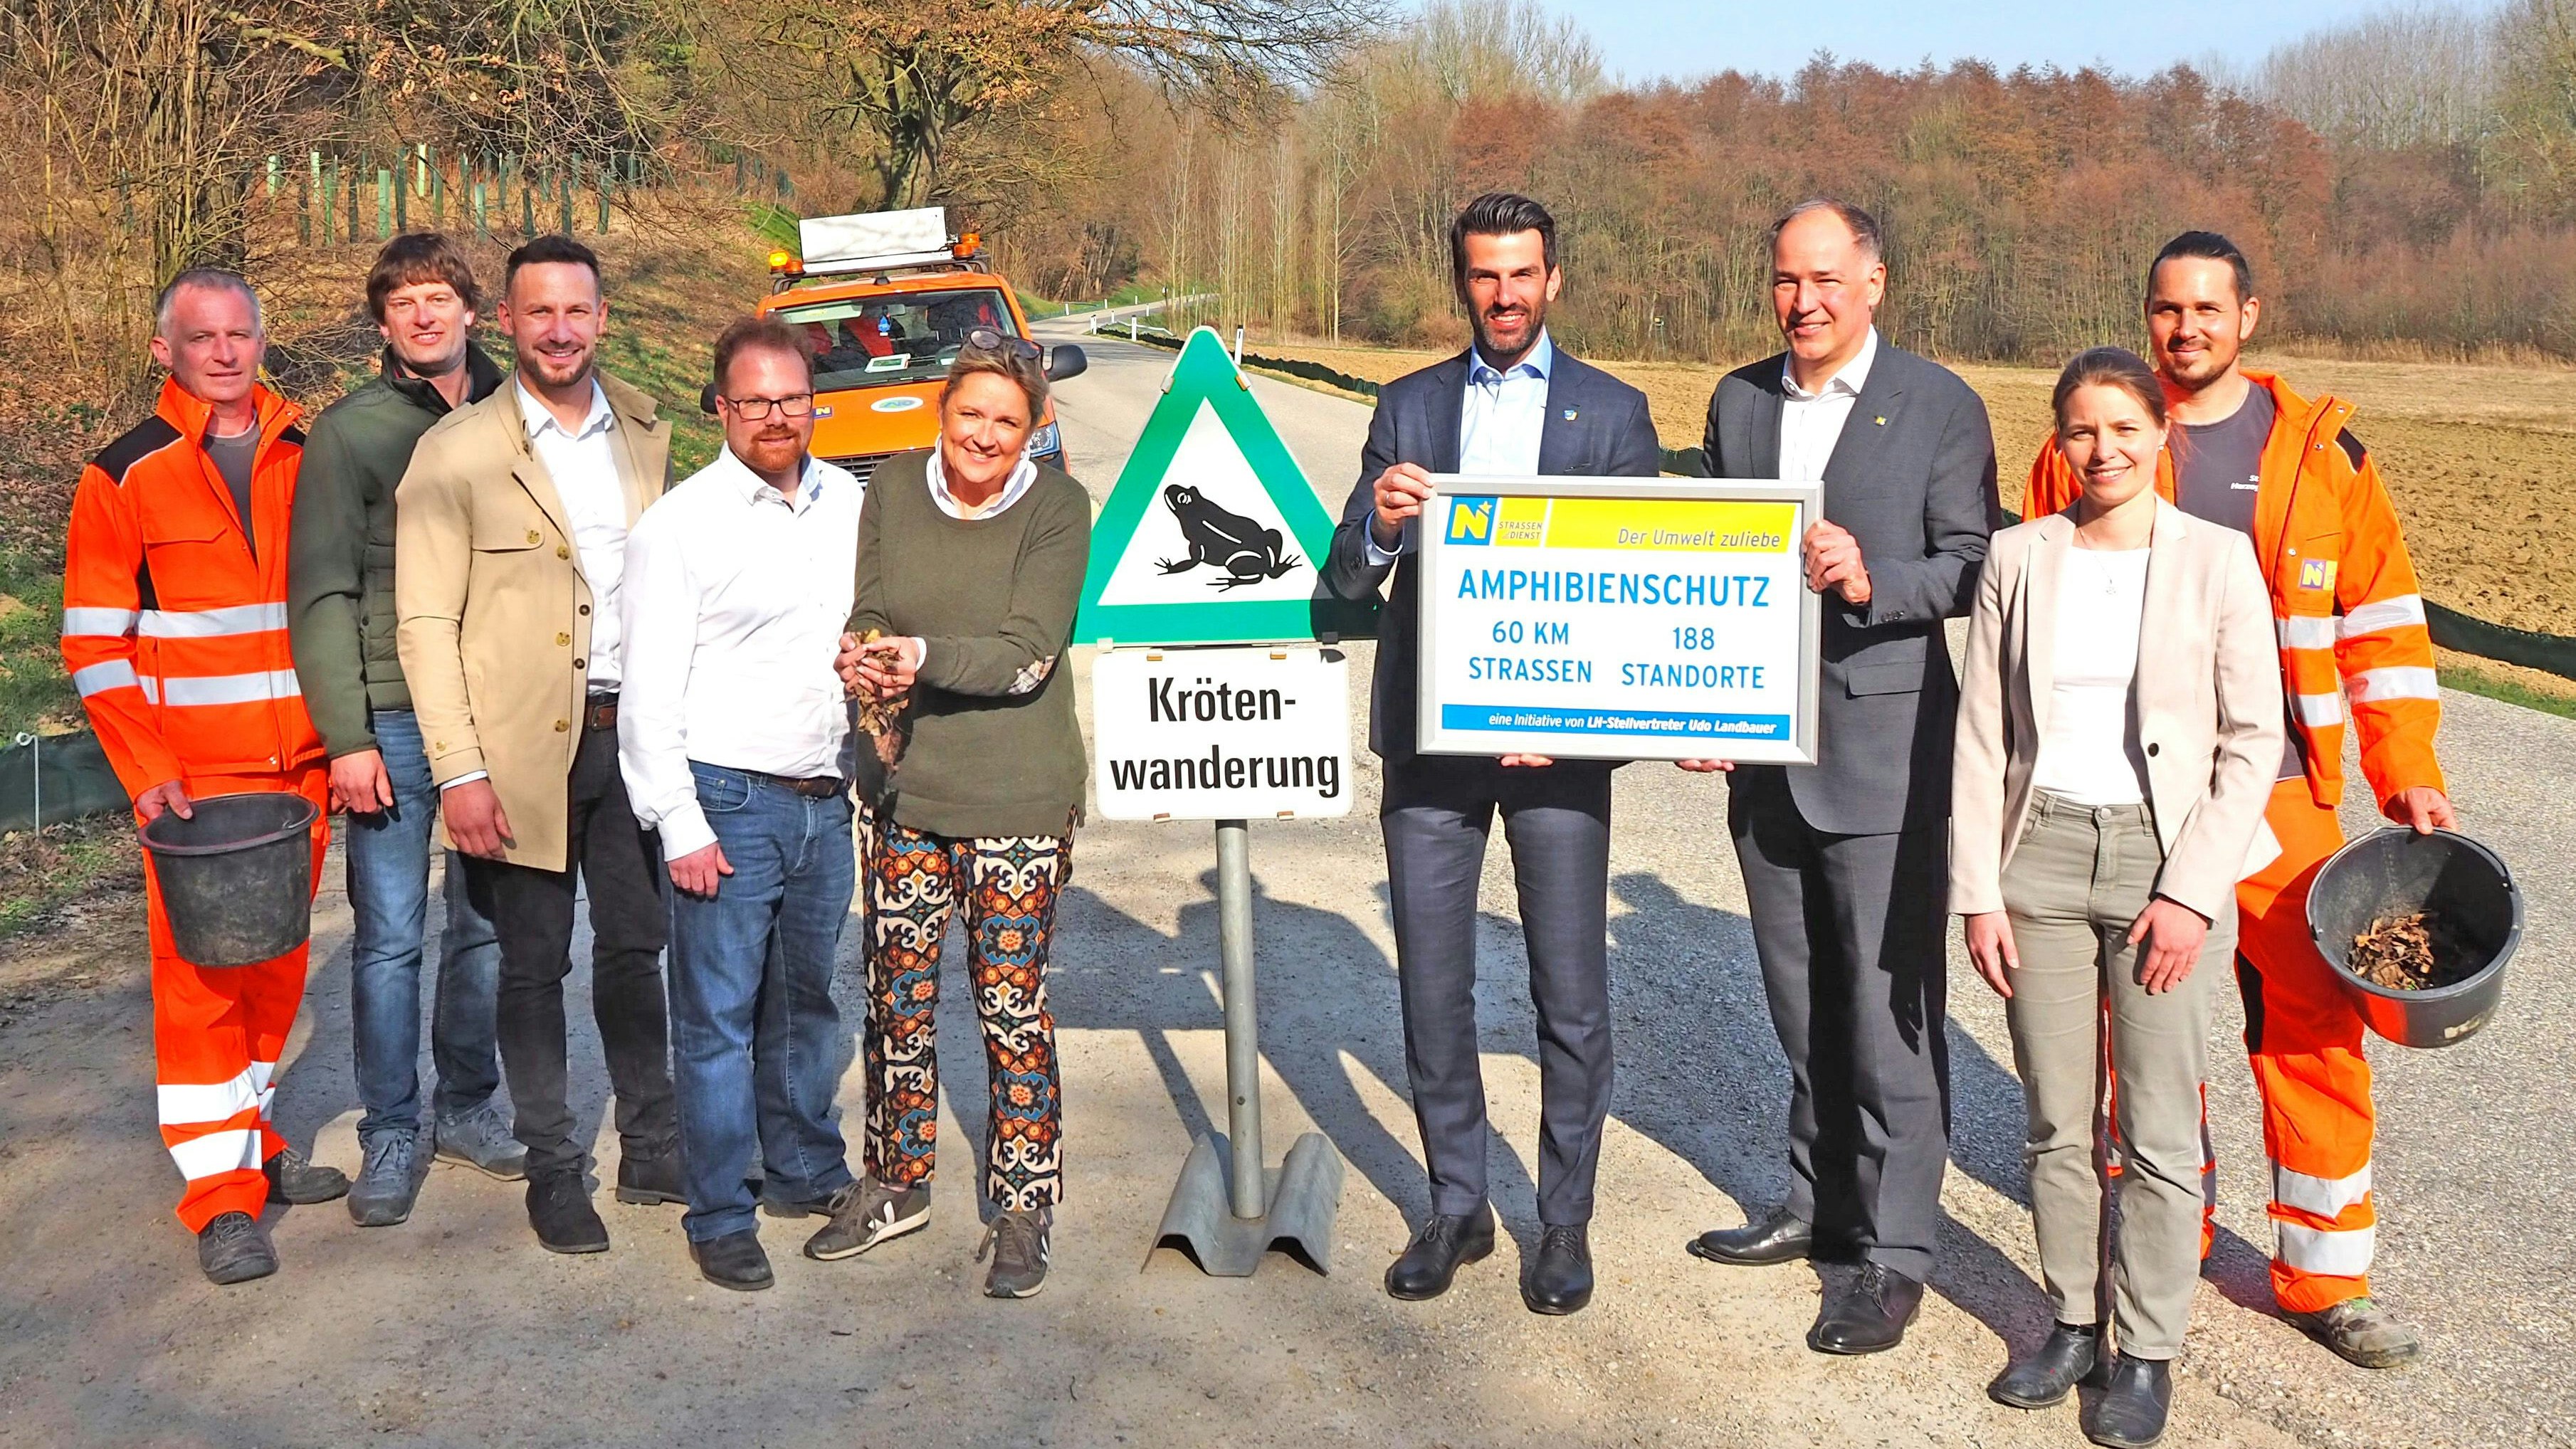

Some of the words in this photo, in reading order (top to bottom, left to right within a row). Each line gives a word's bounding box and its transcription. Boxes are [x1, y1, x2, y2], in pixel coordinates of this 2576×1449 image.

[1499, 522, 1542, 530] STRASSEN
[1510, 531, 1541, 539] DIENST
[1618, 529, 1647, 544] Der
[1654, 529, 1715, 546] Umwelt
[1720, 531, 1780, 547] zuliebe
[1458, 569, 1770, 606] AMPHIBIENSCHUTZ
[1493, 621, 1523, 643] 60
[1535, 622, 1569, 645] KM
[1673, 627, 1715, 650] 188
[1469, 657, 1592, 683] STRASSEN
[1621, 663, 1764, 689] STANDORTE
[1148, 676, 1296, 722] Kröten-
[1489, 712, 1511, 725] eine
[1514, 713, 1562, 727] Initiative
[1565, 717, 1584, 728] von
[1587, 716, 1686, 731] LH-Stellvertreter
[1688, 719, 1712, 732] Udo
[1714, 720, 1777, 734] Landbauer
[1110, 744, 1340, 799] wanderung
